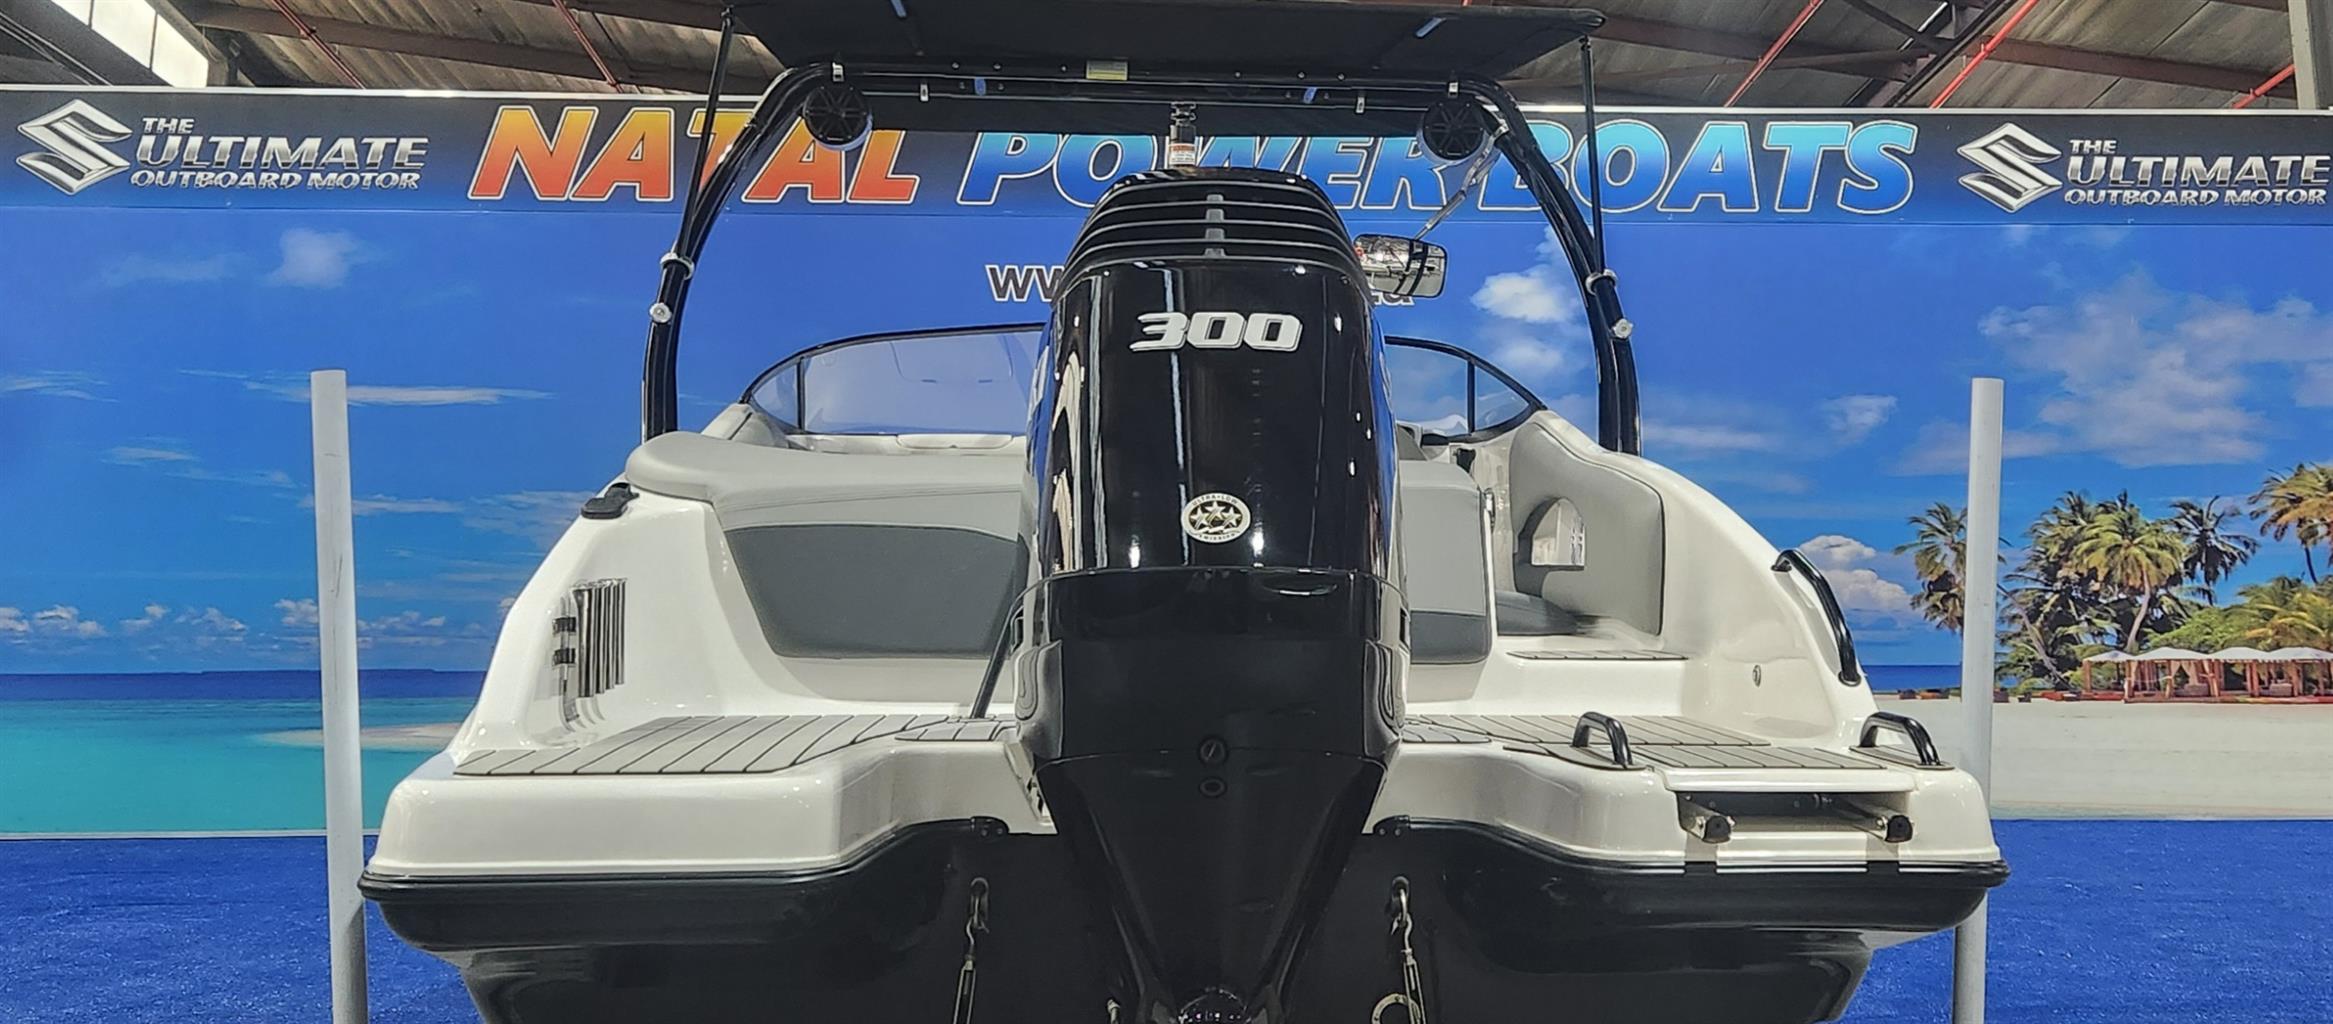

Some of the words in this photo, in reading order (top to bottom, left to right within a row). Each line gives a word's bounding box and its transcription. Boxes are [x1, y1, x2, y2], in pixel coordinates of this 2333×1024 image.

[142, 117, 194, 134] THE
[135, 137, 429, 169] ULTIMATE
[468, 105, 920, 204] NATAL
[1477, 119, 1918, 214] BOATS
[2069, 139, 2117, 155] THE
[130, 170, 303, 189] OUTBOARD
[307, 172, 421, 190] MOTOR
[2066, 155, 2332, 187] ULTIMATE
[2064, 188, 2219, 206] OUTBOARD
[2223, 188, 2327, 206] MOTOR
[1129, 312, 1303, 352] 300
